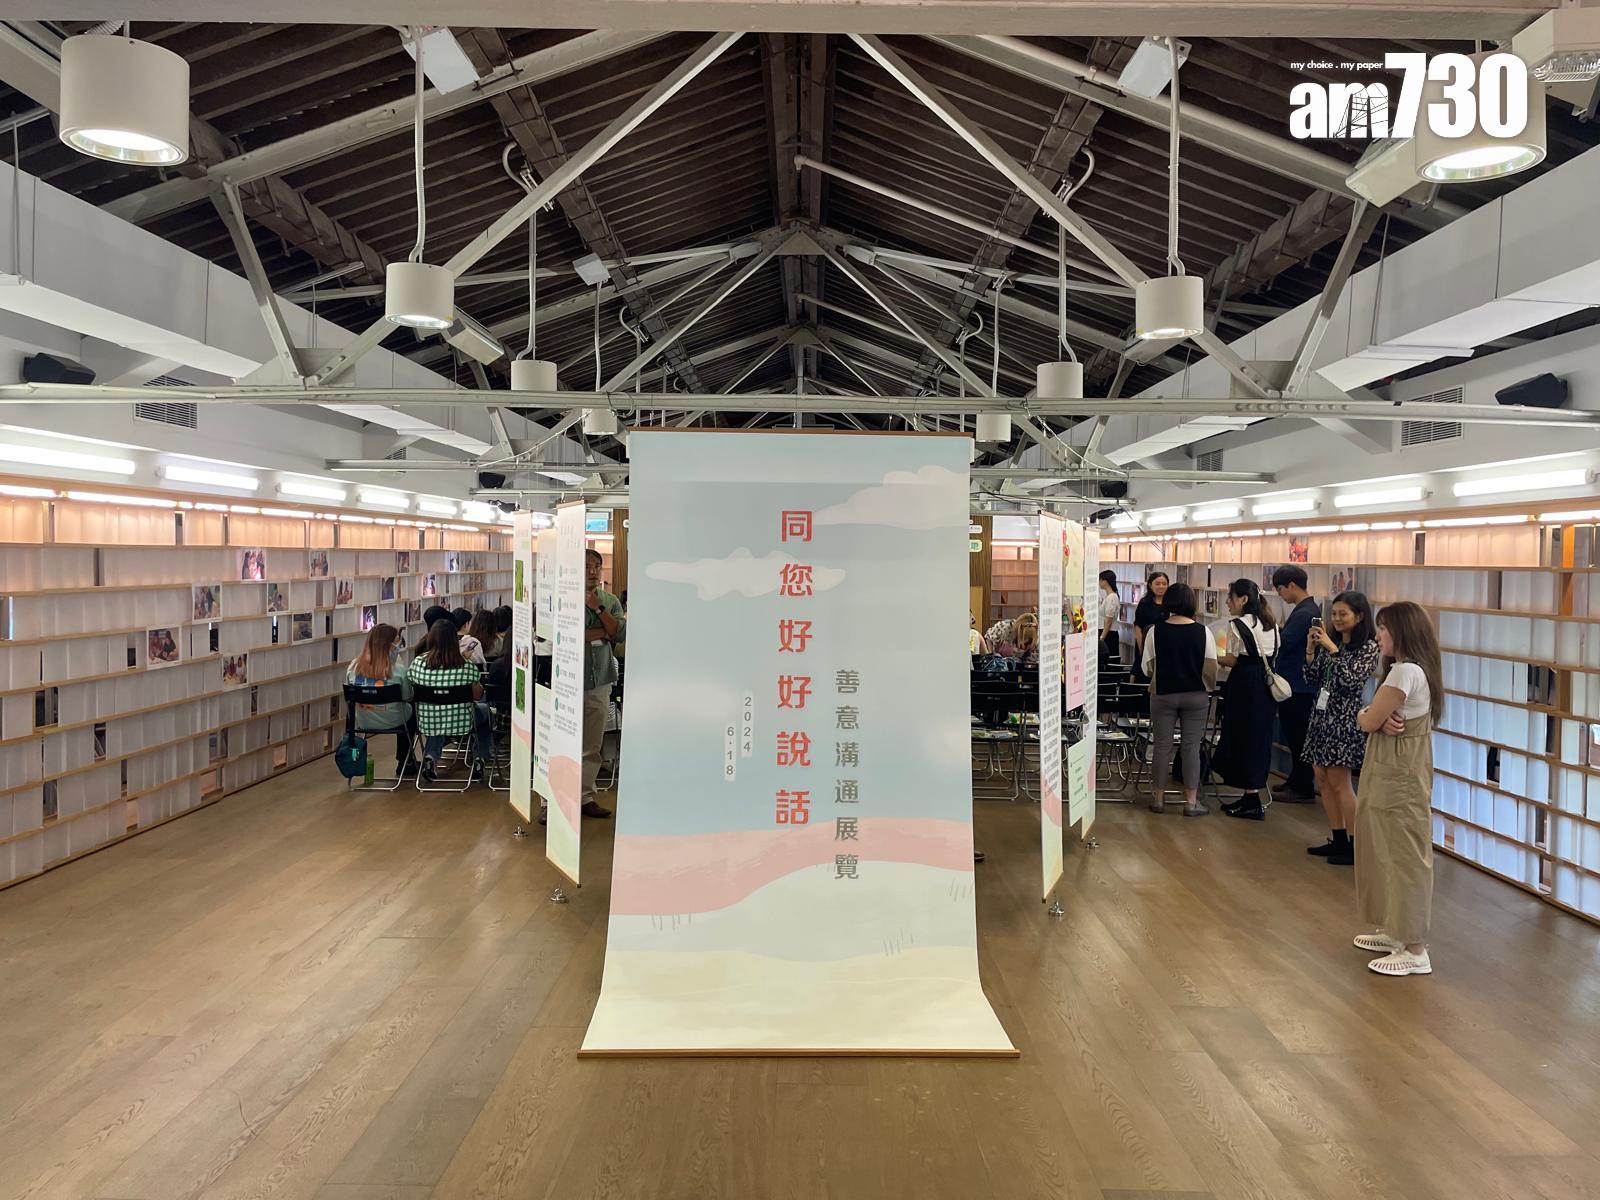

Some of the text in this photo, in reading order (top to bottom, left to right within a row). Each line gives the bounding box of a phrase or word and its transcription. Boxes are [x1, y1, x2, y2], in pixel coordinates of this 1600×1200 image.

[743, 696, 752, 753] 2024
[775, 510, 814, 825] 同您好好說話
[834, 668, 861, 880] 善意溝通展覽
